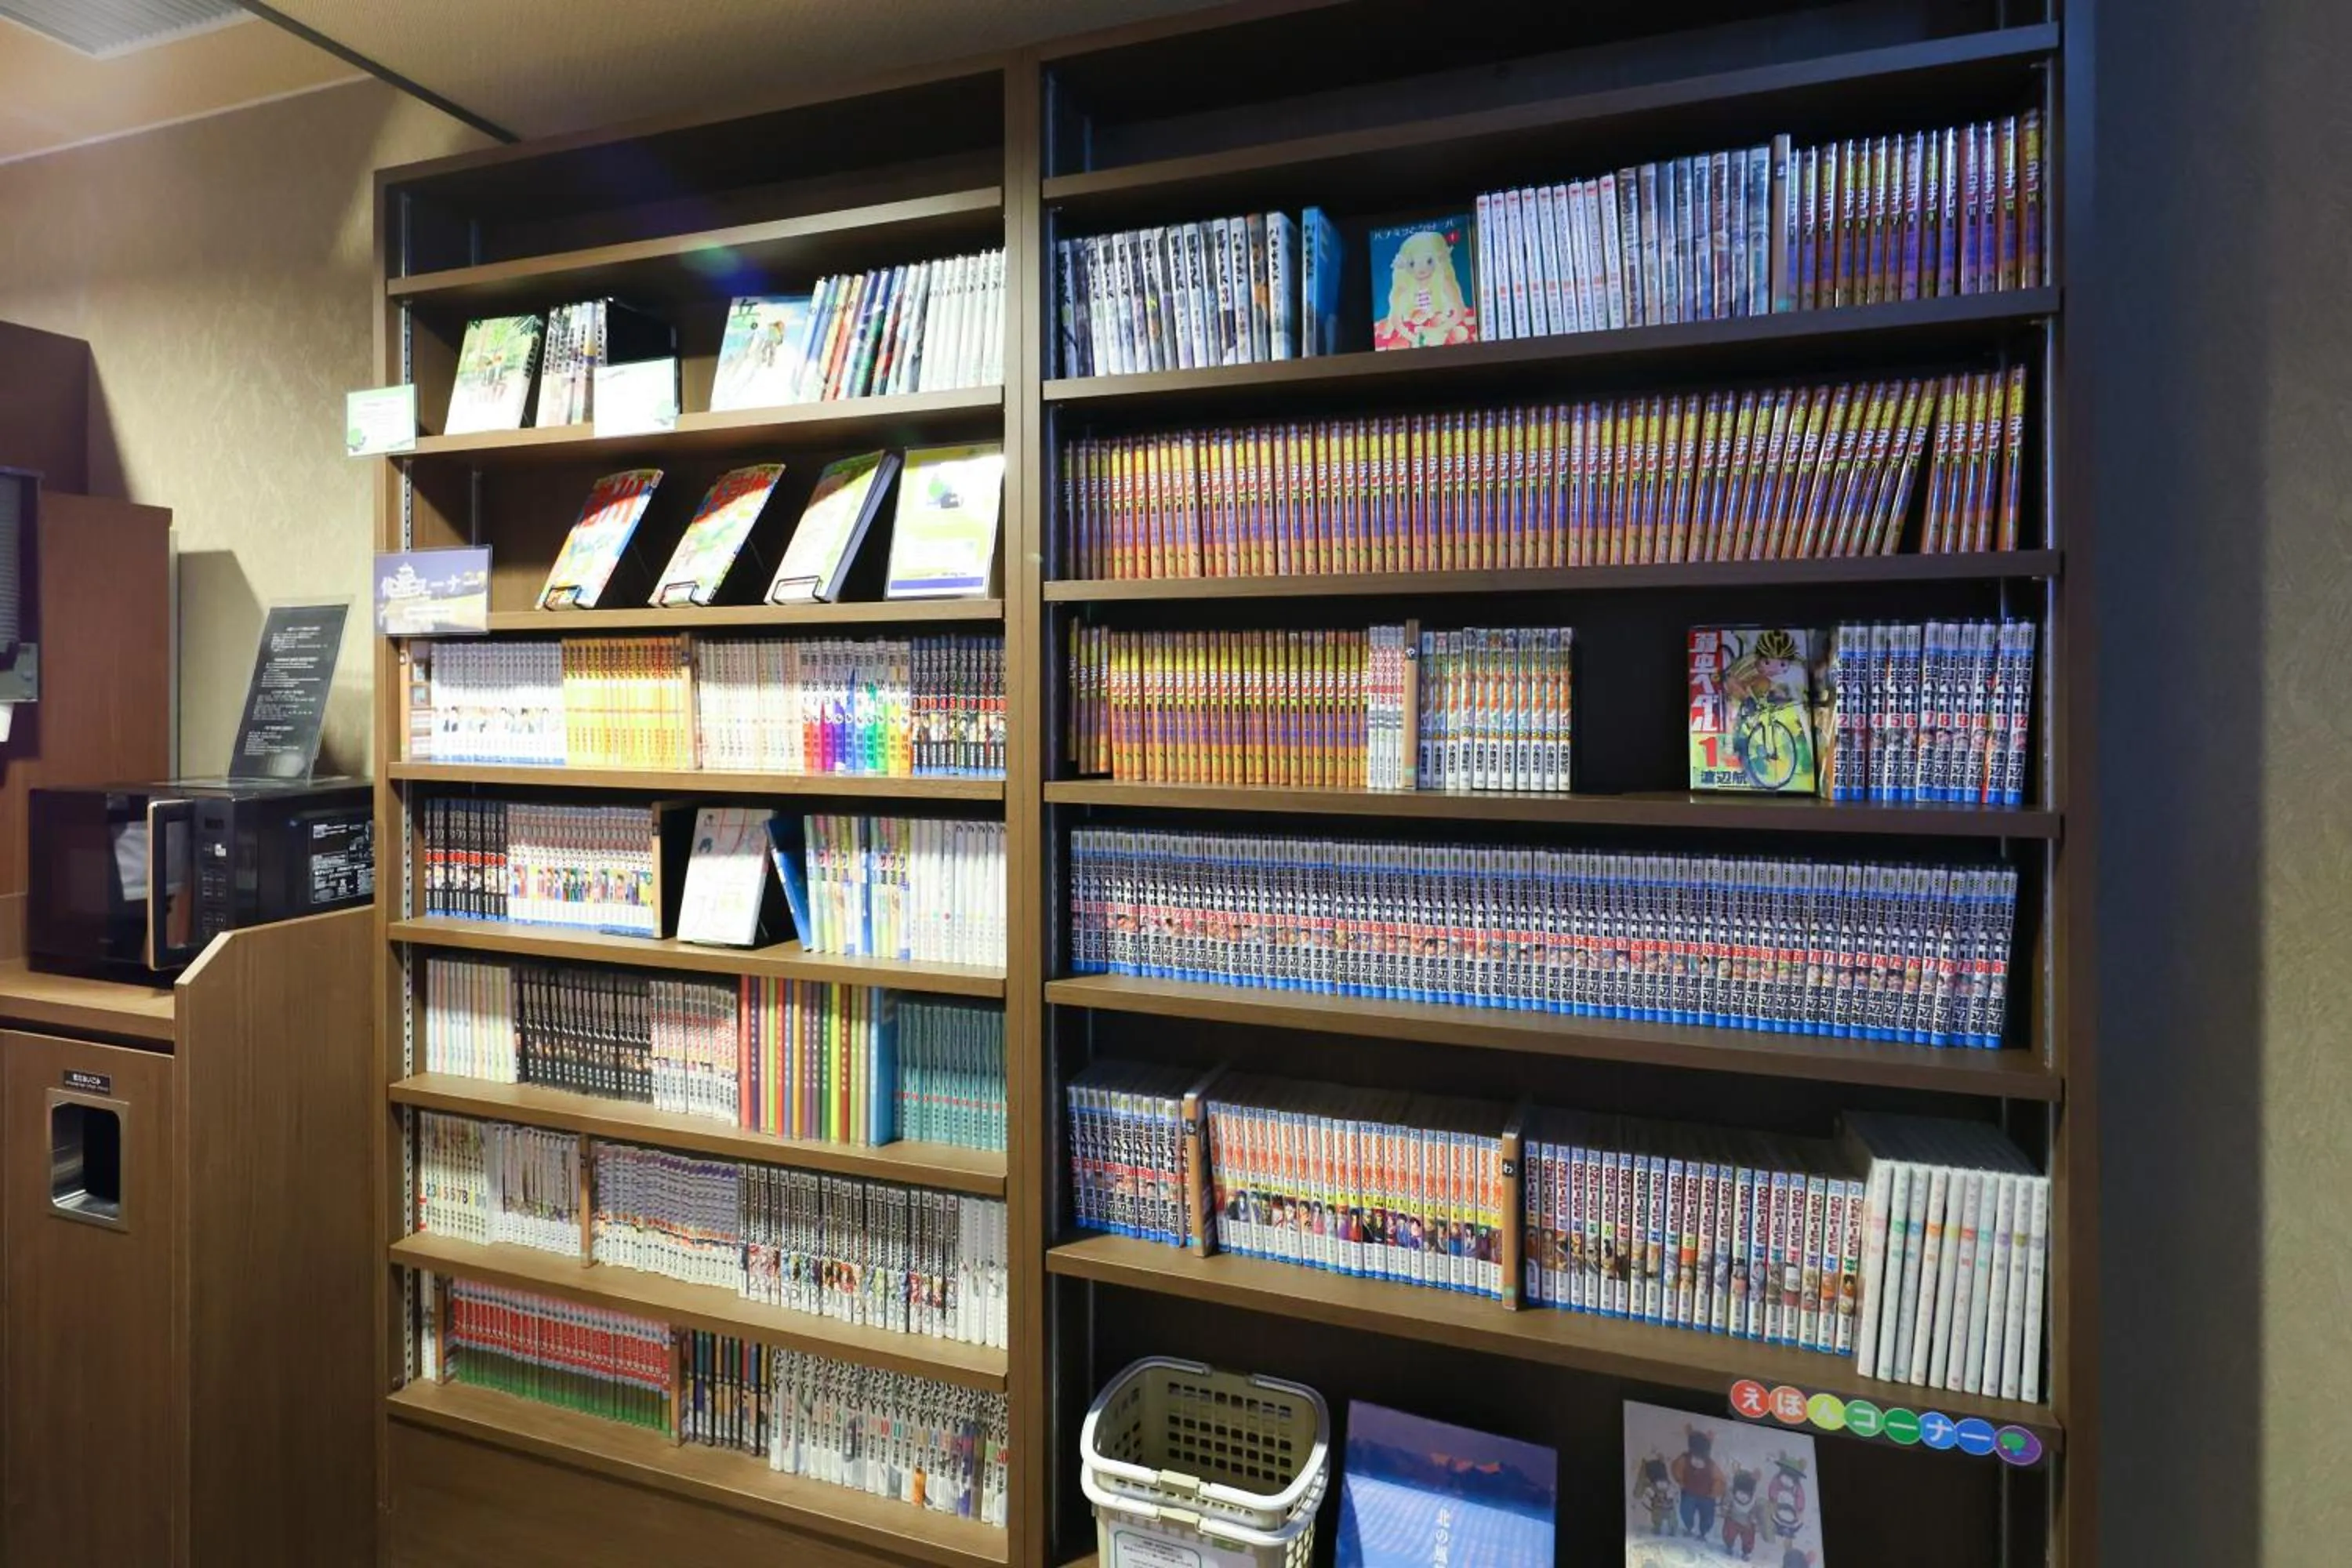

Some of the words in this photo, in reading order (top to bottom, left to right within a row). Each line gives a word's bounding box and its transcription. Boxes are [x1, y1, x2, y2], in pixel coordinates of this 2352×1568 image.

[1690, 633, 1719, 731] 弱虫ペダル
[1838, 715, 1847, 726] 2
[1855, 715, 1864, 726] 3
[1873, 715, 1882, 726] 4
[1891, 715, 1900, 726] 5
[1906, 715, 1915, 726] 6
[1926, 712, 1934, 724] 7
[1940, 715, 1951, 727] 8
[1958, 715, 1968, 727] 9
[1974, 715, 1987, 728] 10
[1996, 716, 2007, 728] 11
[2014, 716, 2027, 728] 12
[1741, 1388, 1991, 1441] えほんコーナー
